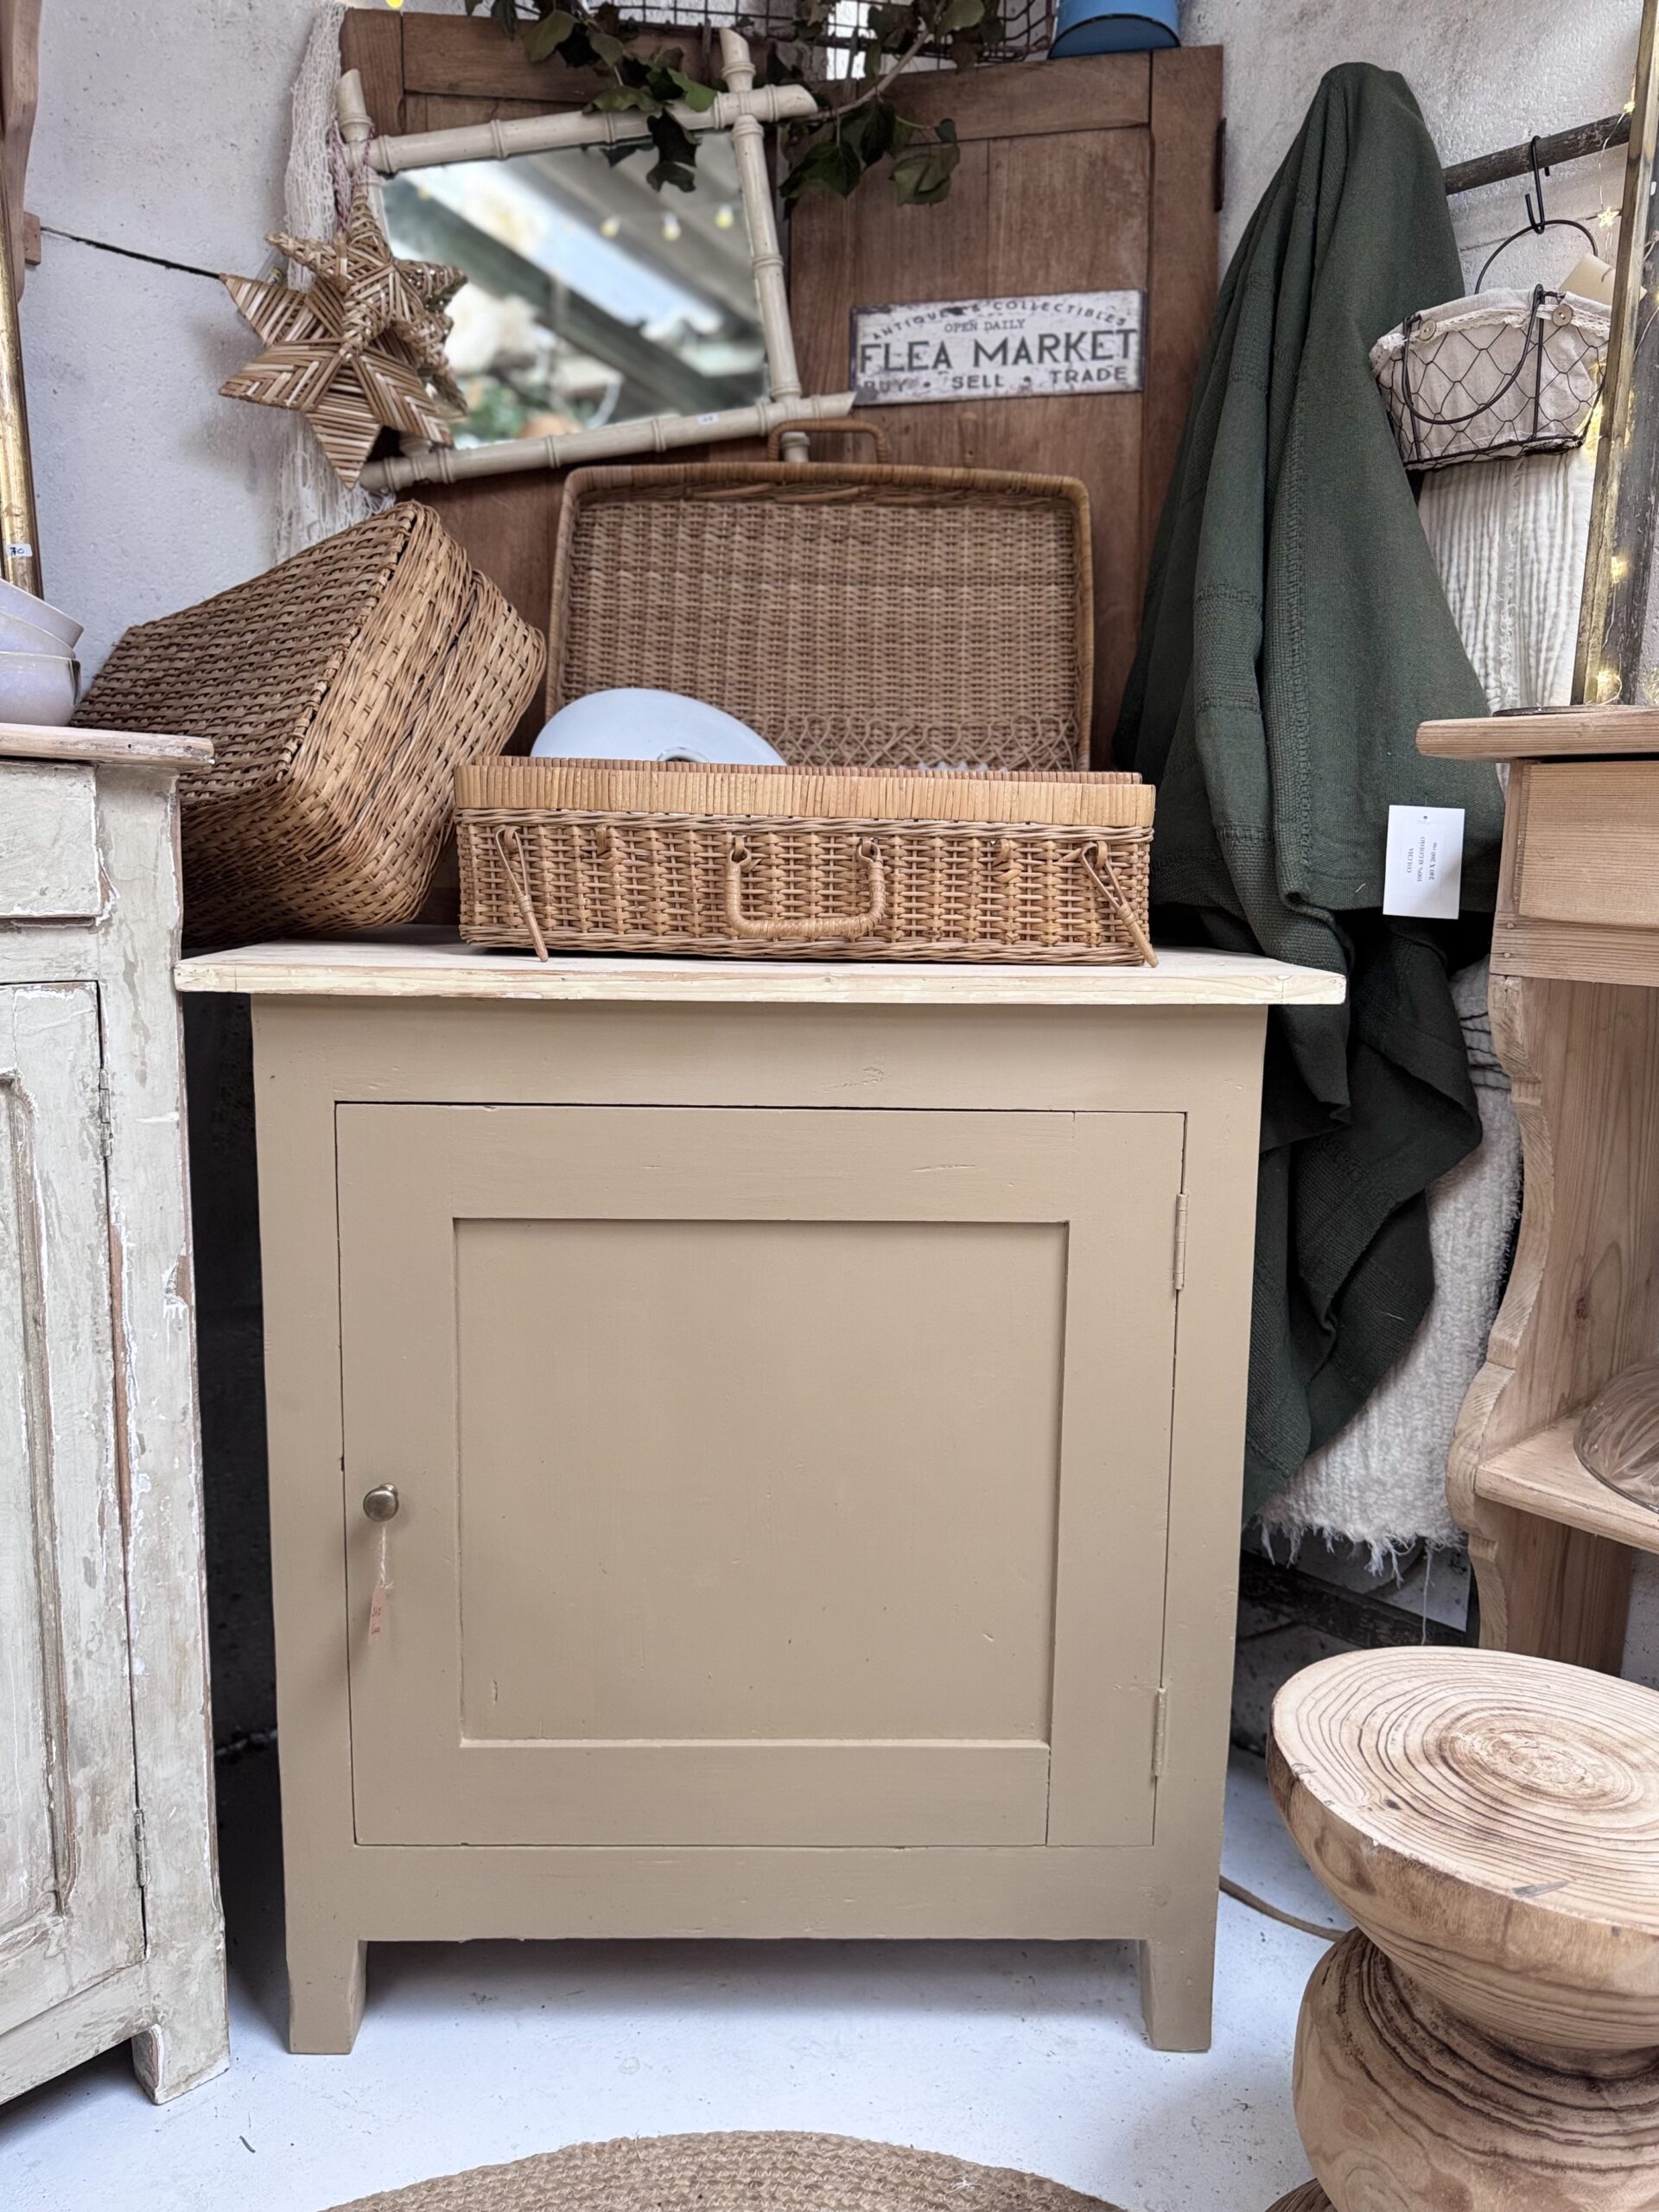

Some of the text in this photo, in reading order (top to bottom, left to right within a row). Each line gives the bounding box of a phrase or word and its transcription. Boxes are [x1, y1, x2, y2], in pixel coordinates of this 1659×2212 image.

[873, 305, 965, 340] ANTIQUE
[994, 300, 1127, 327] COLLECTIBLES
[944, 318, 1026, 334] OPEN DAILY
[860, 328, 1137, 374] FLEA MARKET
[951, 373, 1005, 390] SELL
[1049, 366, 1128, 384] TRADE
